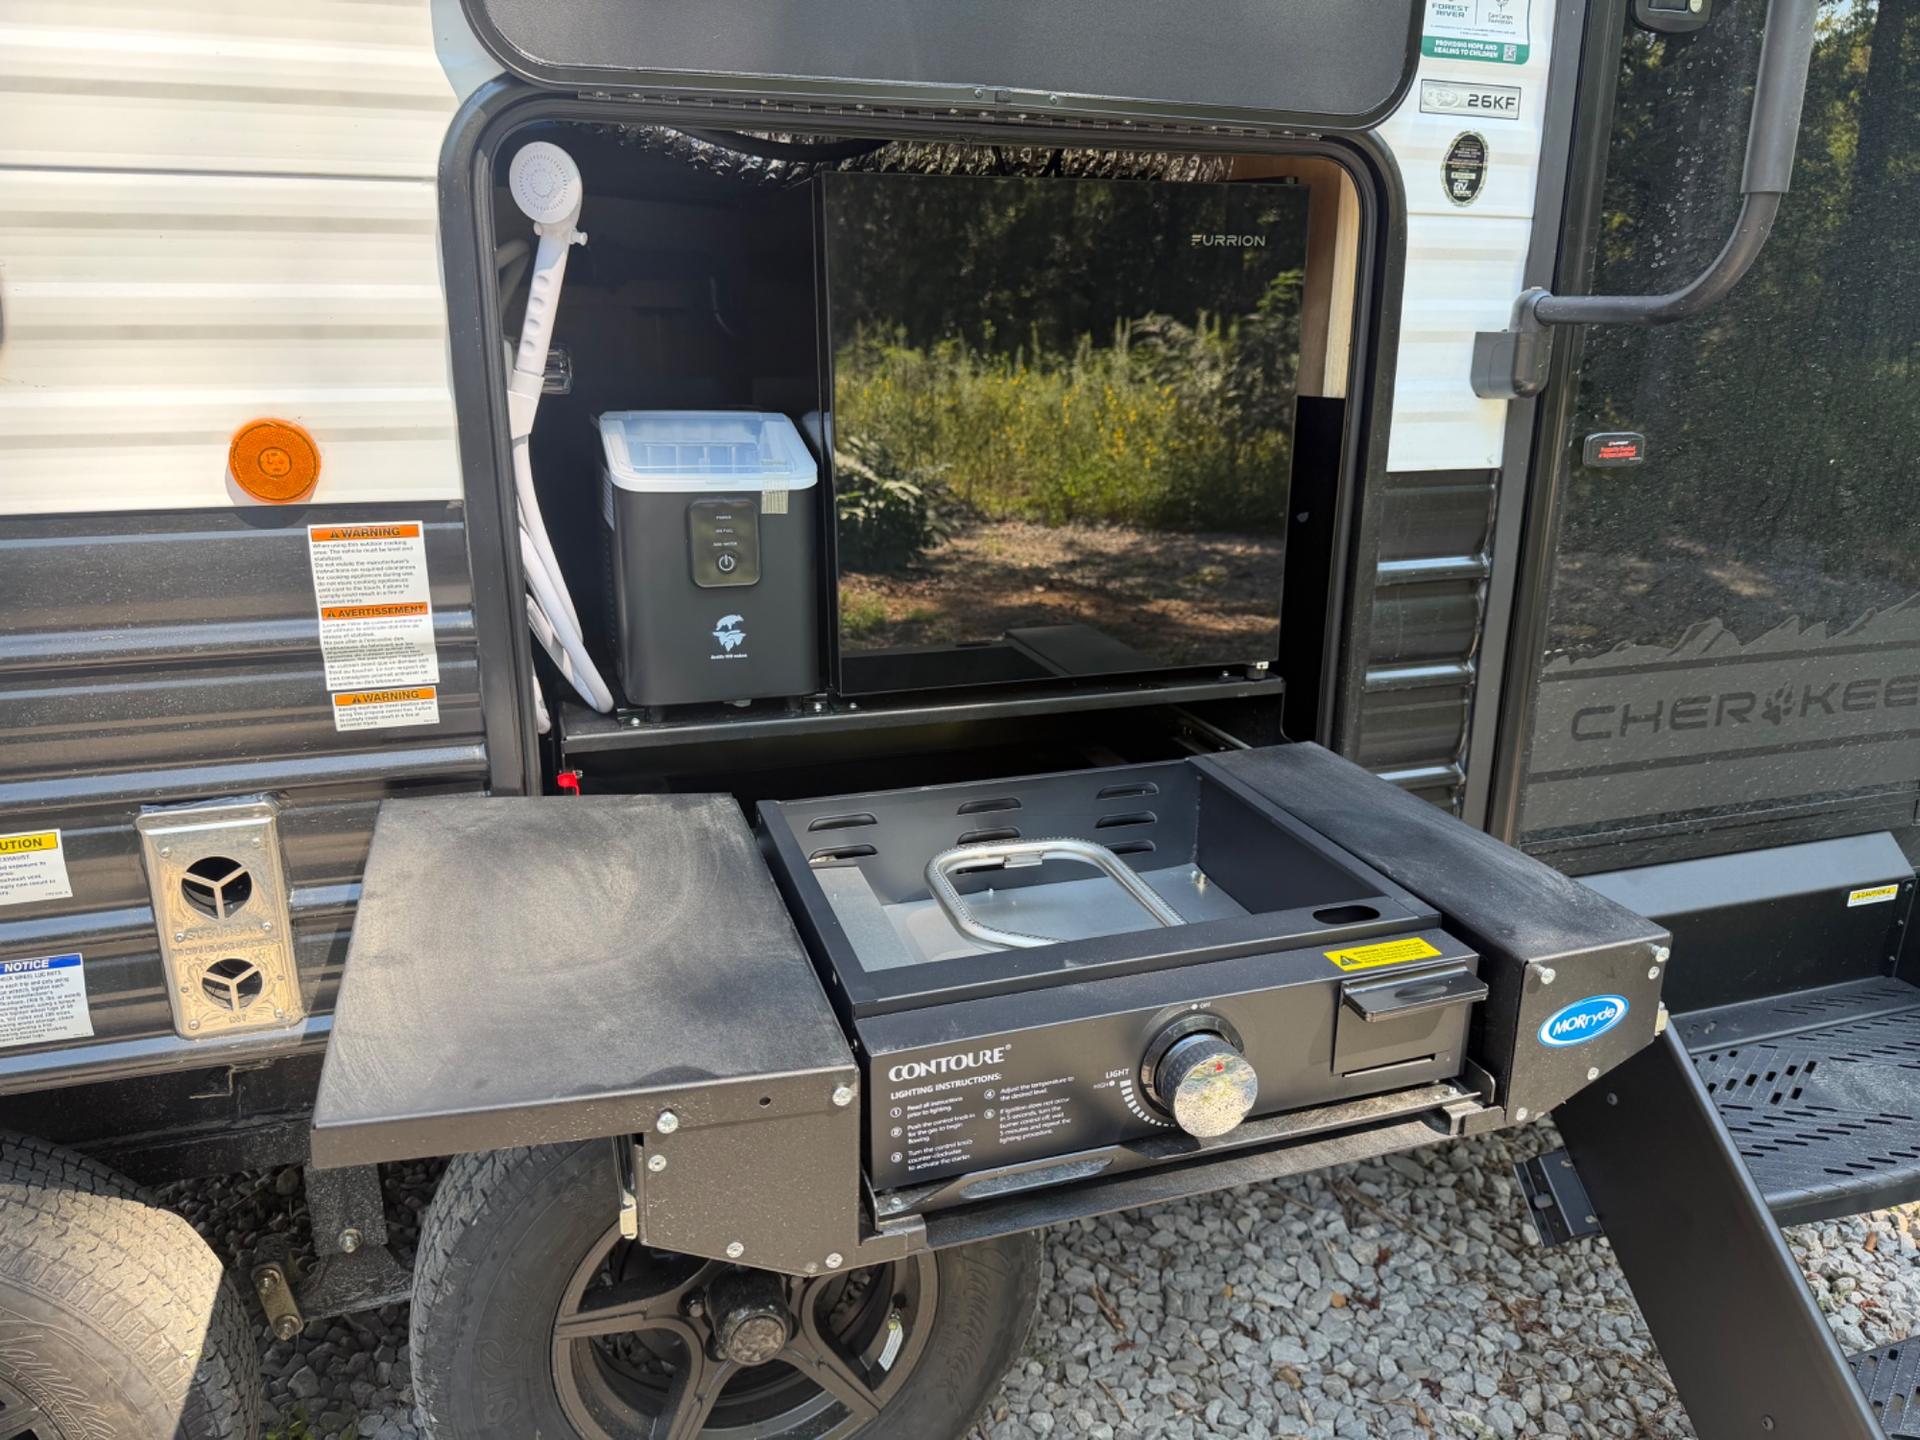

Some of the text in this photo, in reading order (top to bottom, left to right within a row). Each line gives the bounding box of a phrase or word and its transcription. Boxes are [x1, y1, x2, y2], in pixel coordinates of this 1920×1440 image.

[1432, 3, 1469, 12] FOREST
[1436, 10, 1465, 18] RIVER
[1468, 42, 1484, 50] HOPE
[1434, 46, 1460, 55] HEALING
[1470, 50, 1499, 58] CHILDREN
[1467, 94, 1516, 110] 26KF
[1191, 234, 1266, 247] FURRION
[341, 527, 400, 538] WARNING
[338, 604, 424, 618] AVERTISSEMENT
[362, 690, 419, 703] WARNING
[4, 959, 49, 973] NOTICE
[1552, 1006, 1616, 1036] MORryde
[1105, 1068, 1130, 1078] LIGHT
[890, 1072, 1002, 1100] LIGHTING INSTRUCTIONS:
[1000, 1086, 1020, 1094] Adjust
[1030, 1078, 1067, 1088] temperature
[1011, 1090, 1033, 1099] desired
[907, 1103, 922, 1111] Read
[907, 1112, 921, 1120] prior
[1020, 1117, 1041, 1125] control
[907, 1123, 921, 1131] Push
[932, 1117, 953, 1126] control
[1004, 1127, 1030, 1135] minutes
[934, 1141, 957, 1151] control
[916, 1161, 939, 1169] activate
